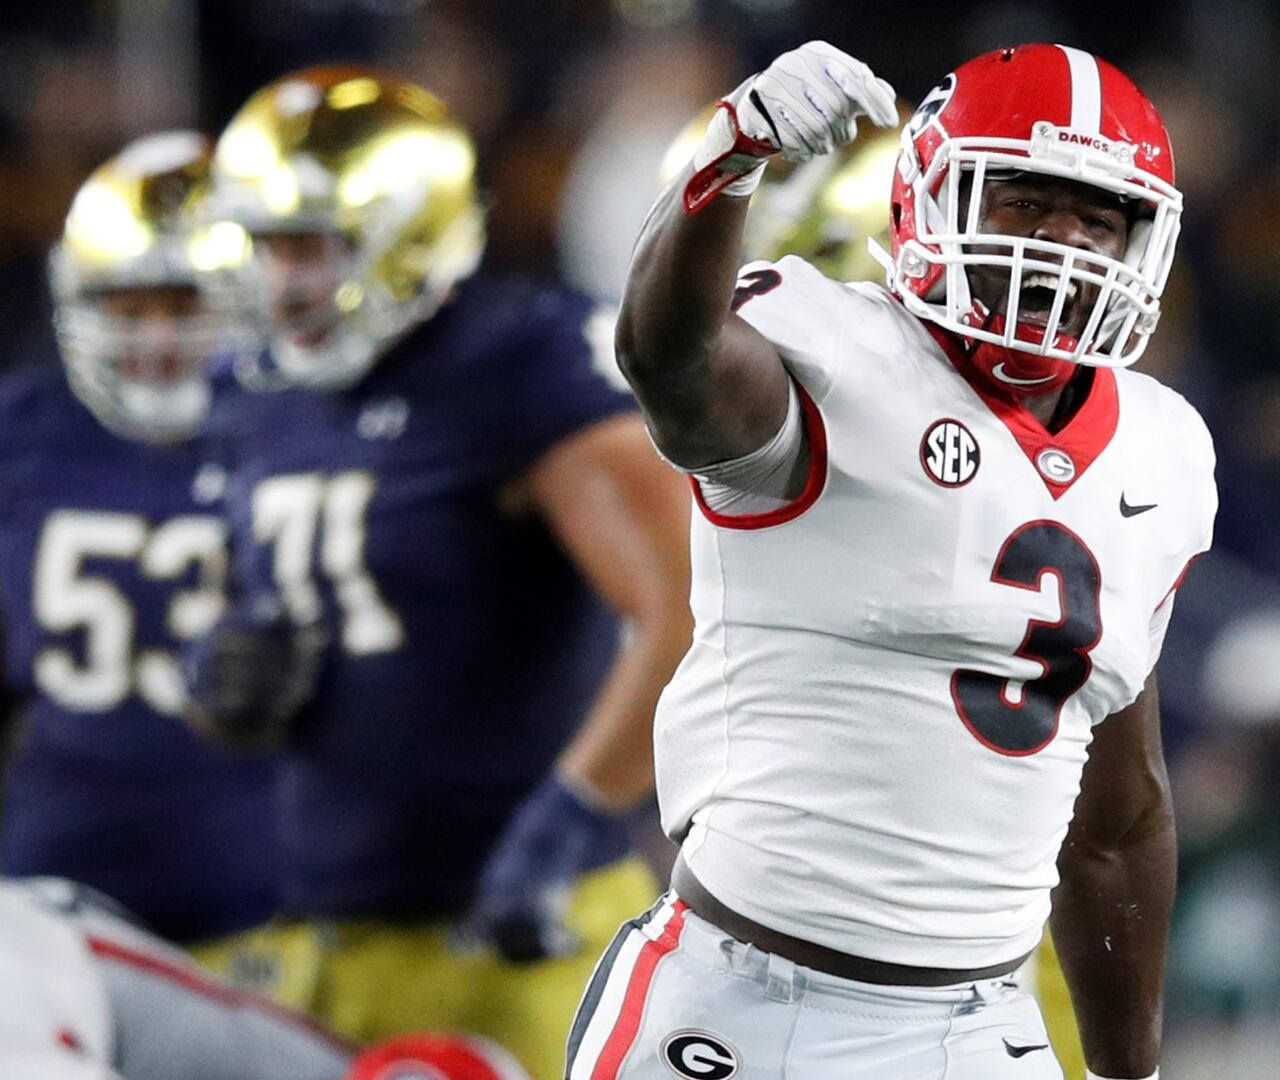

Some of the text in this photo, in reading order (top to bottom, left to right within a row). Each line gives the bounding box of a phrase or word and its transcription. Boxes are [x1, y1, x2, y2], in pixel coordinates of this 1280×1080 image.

[1059, 132, 1109, 152] DAWGS
[925, 422, 977, 484] SEC
[1038, 449, 1075, 481] G
[33, 509, 225, 714] 53
[252, 471, 403, 655] 71
[951, 520, 1103, 757] 3
